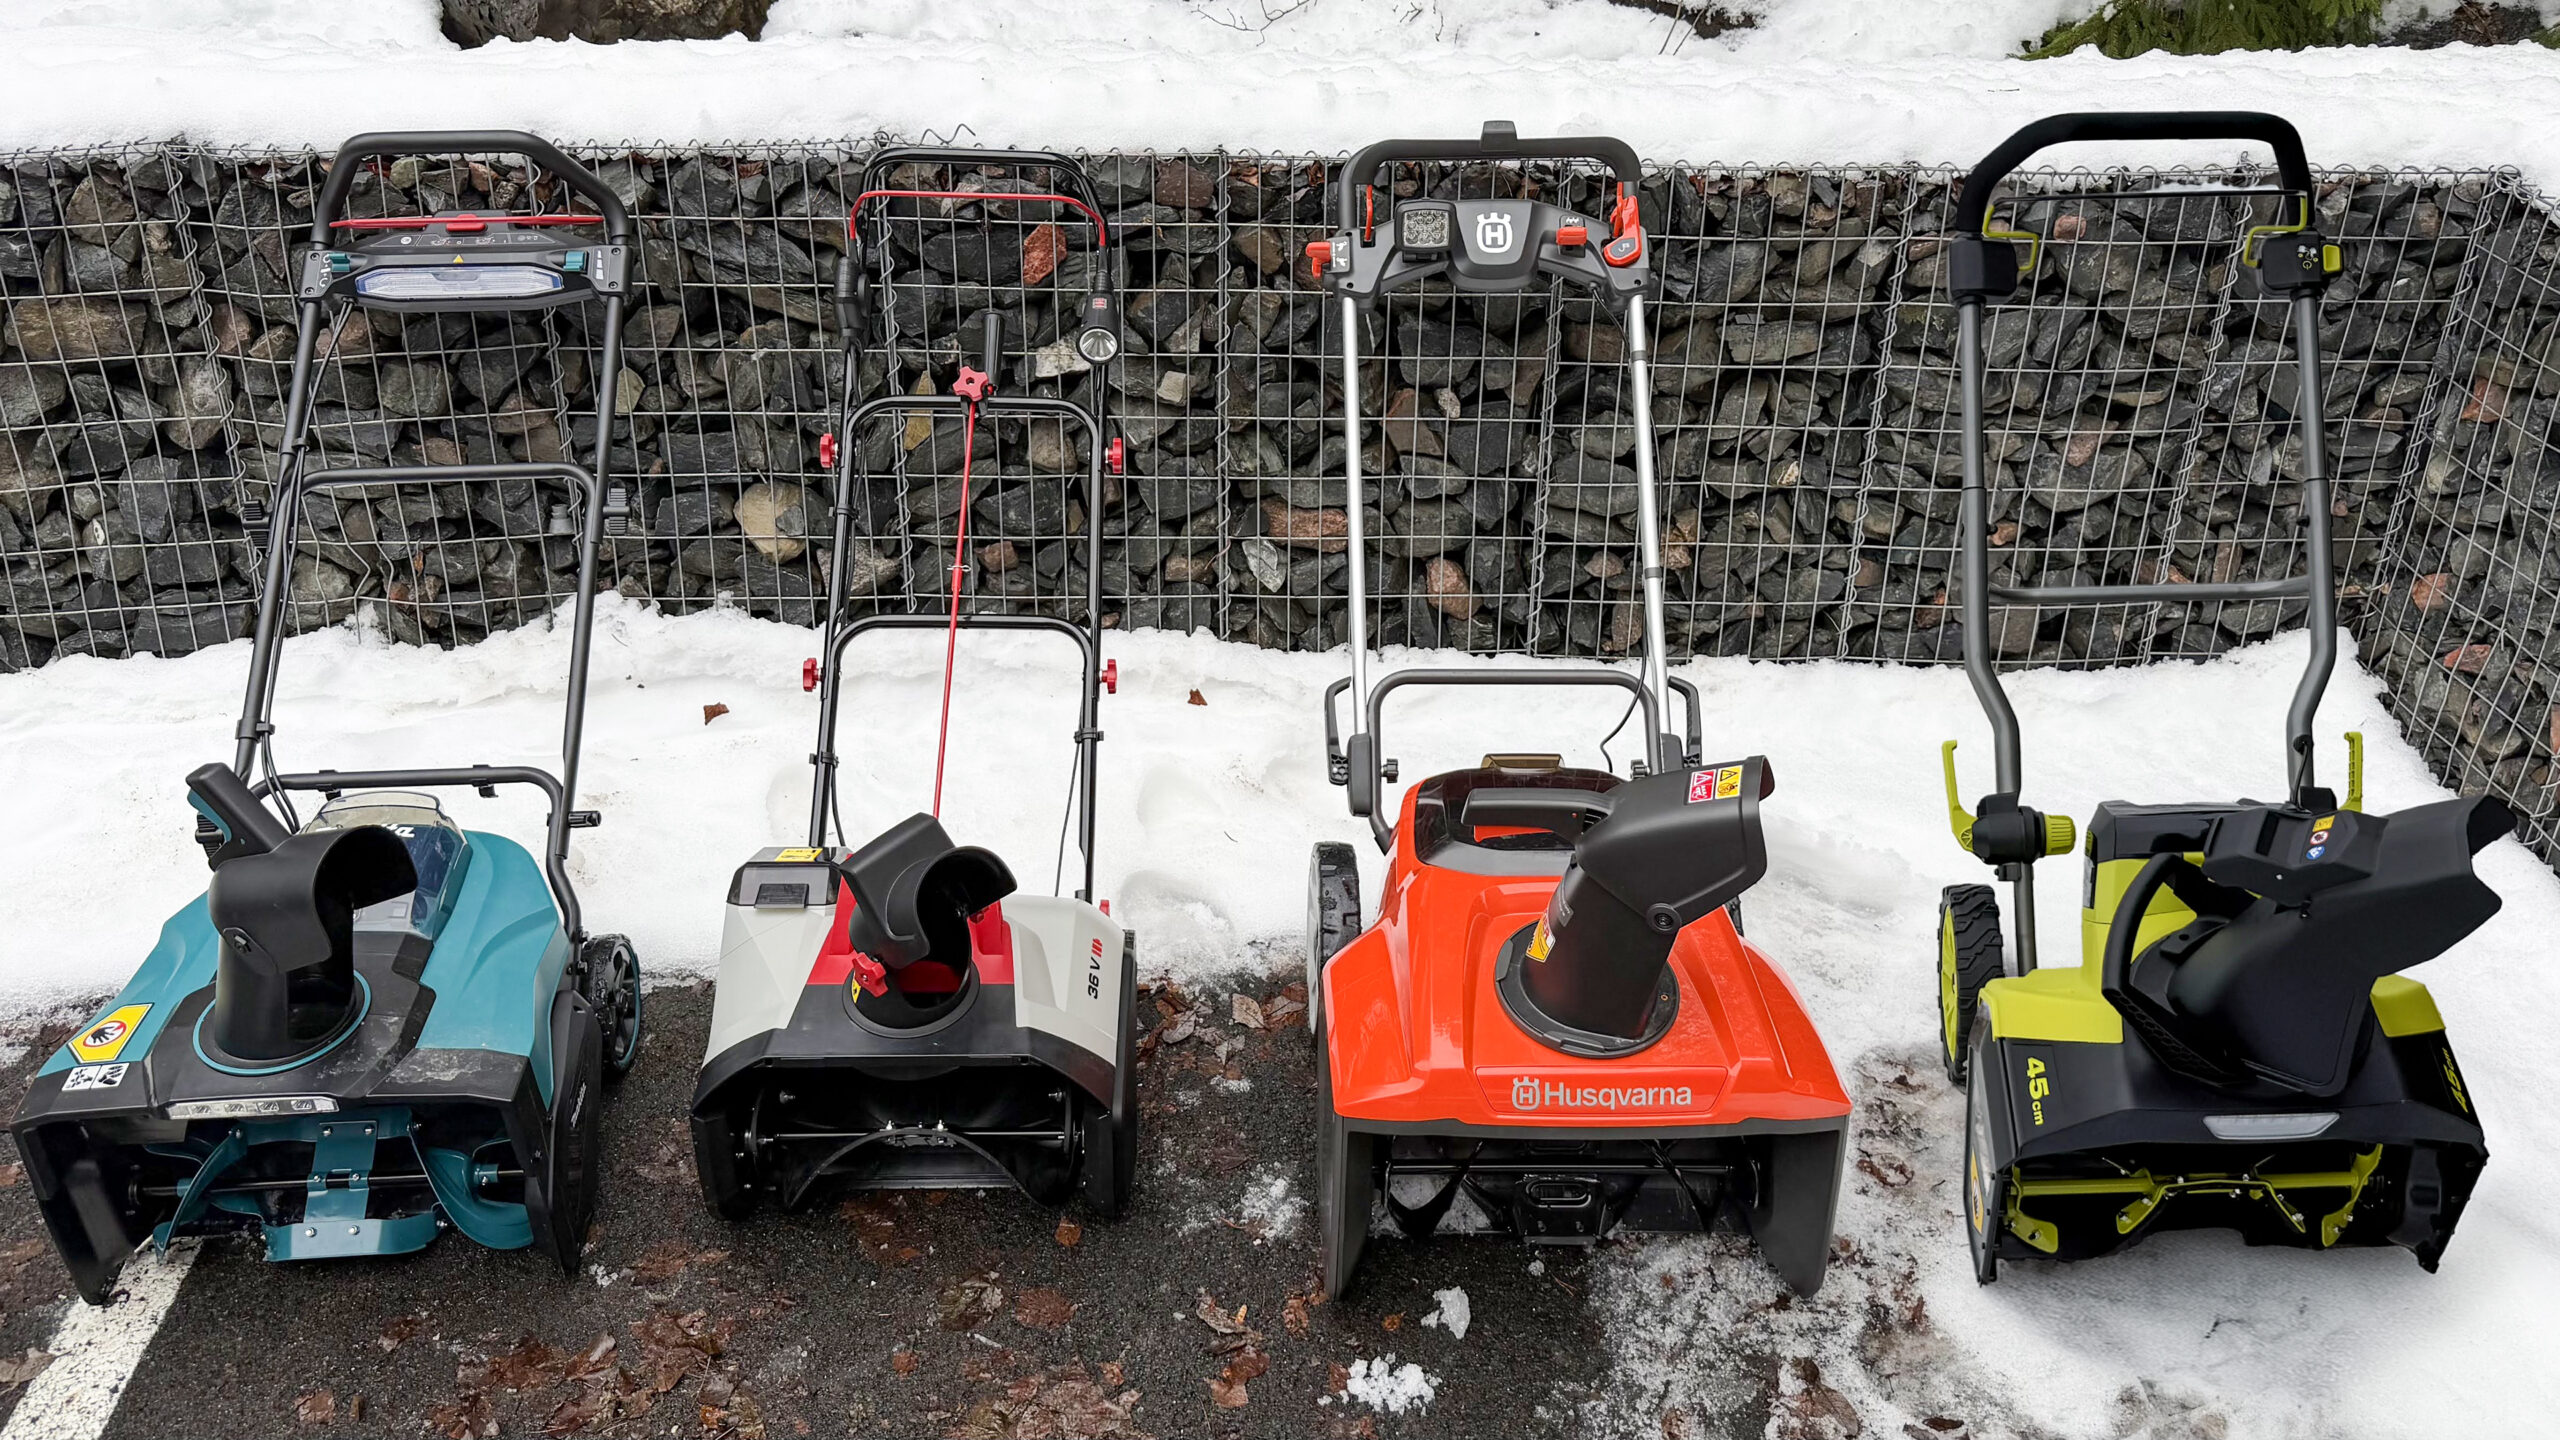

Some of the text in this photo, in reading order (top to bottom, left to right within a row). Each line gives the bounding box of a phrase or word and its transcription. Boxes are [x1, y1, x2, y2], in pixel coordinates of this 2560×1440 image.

[1087, 956, 1101, 1000] 36 V
[1544, 1082, 1692, 1110] Husqvarna
